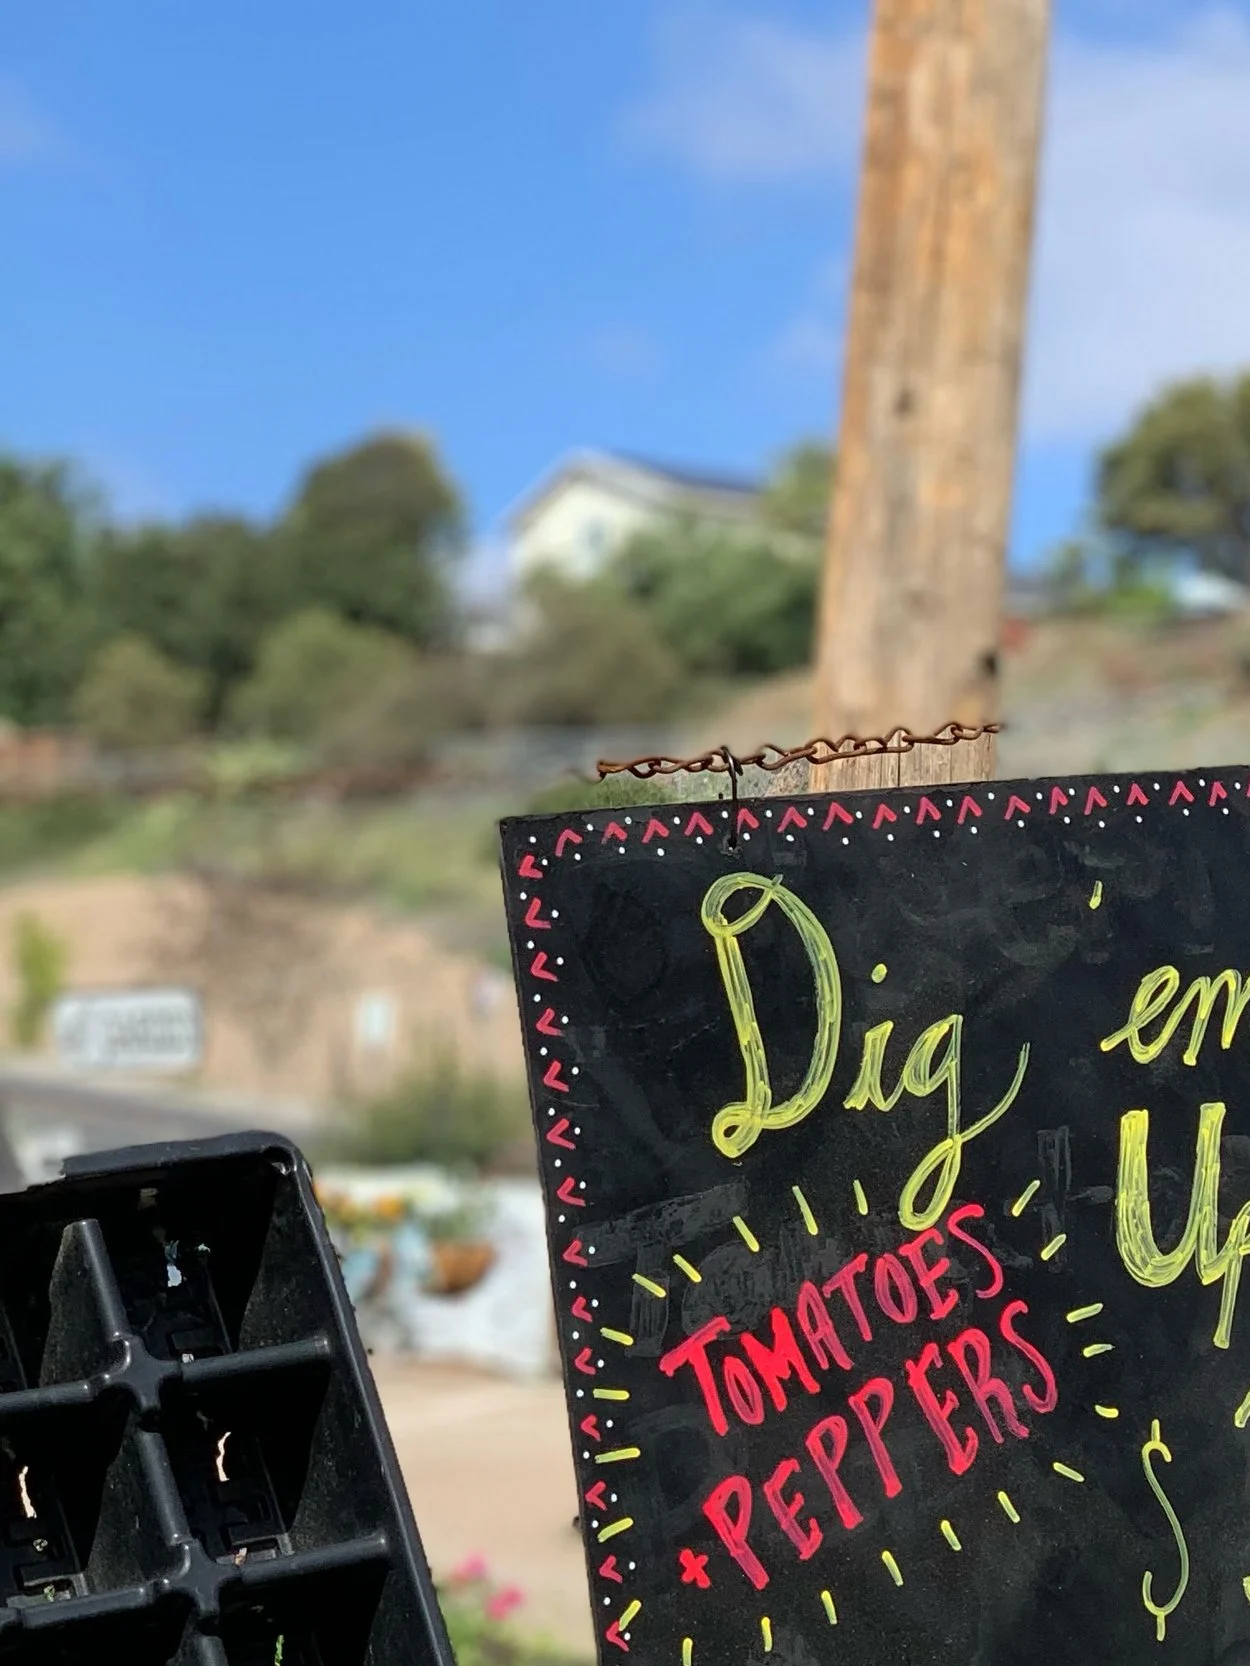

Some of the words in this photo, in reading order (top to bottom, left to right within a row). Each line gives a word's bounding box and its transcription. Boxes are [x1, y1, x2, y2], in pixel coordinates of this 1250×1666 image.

[699, 872, 1029, 1232] Dig
[658, 1203, 1005, 1437] TOMATOES
[701, 1298, 1059, 1591] PEPPERS
